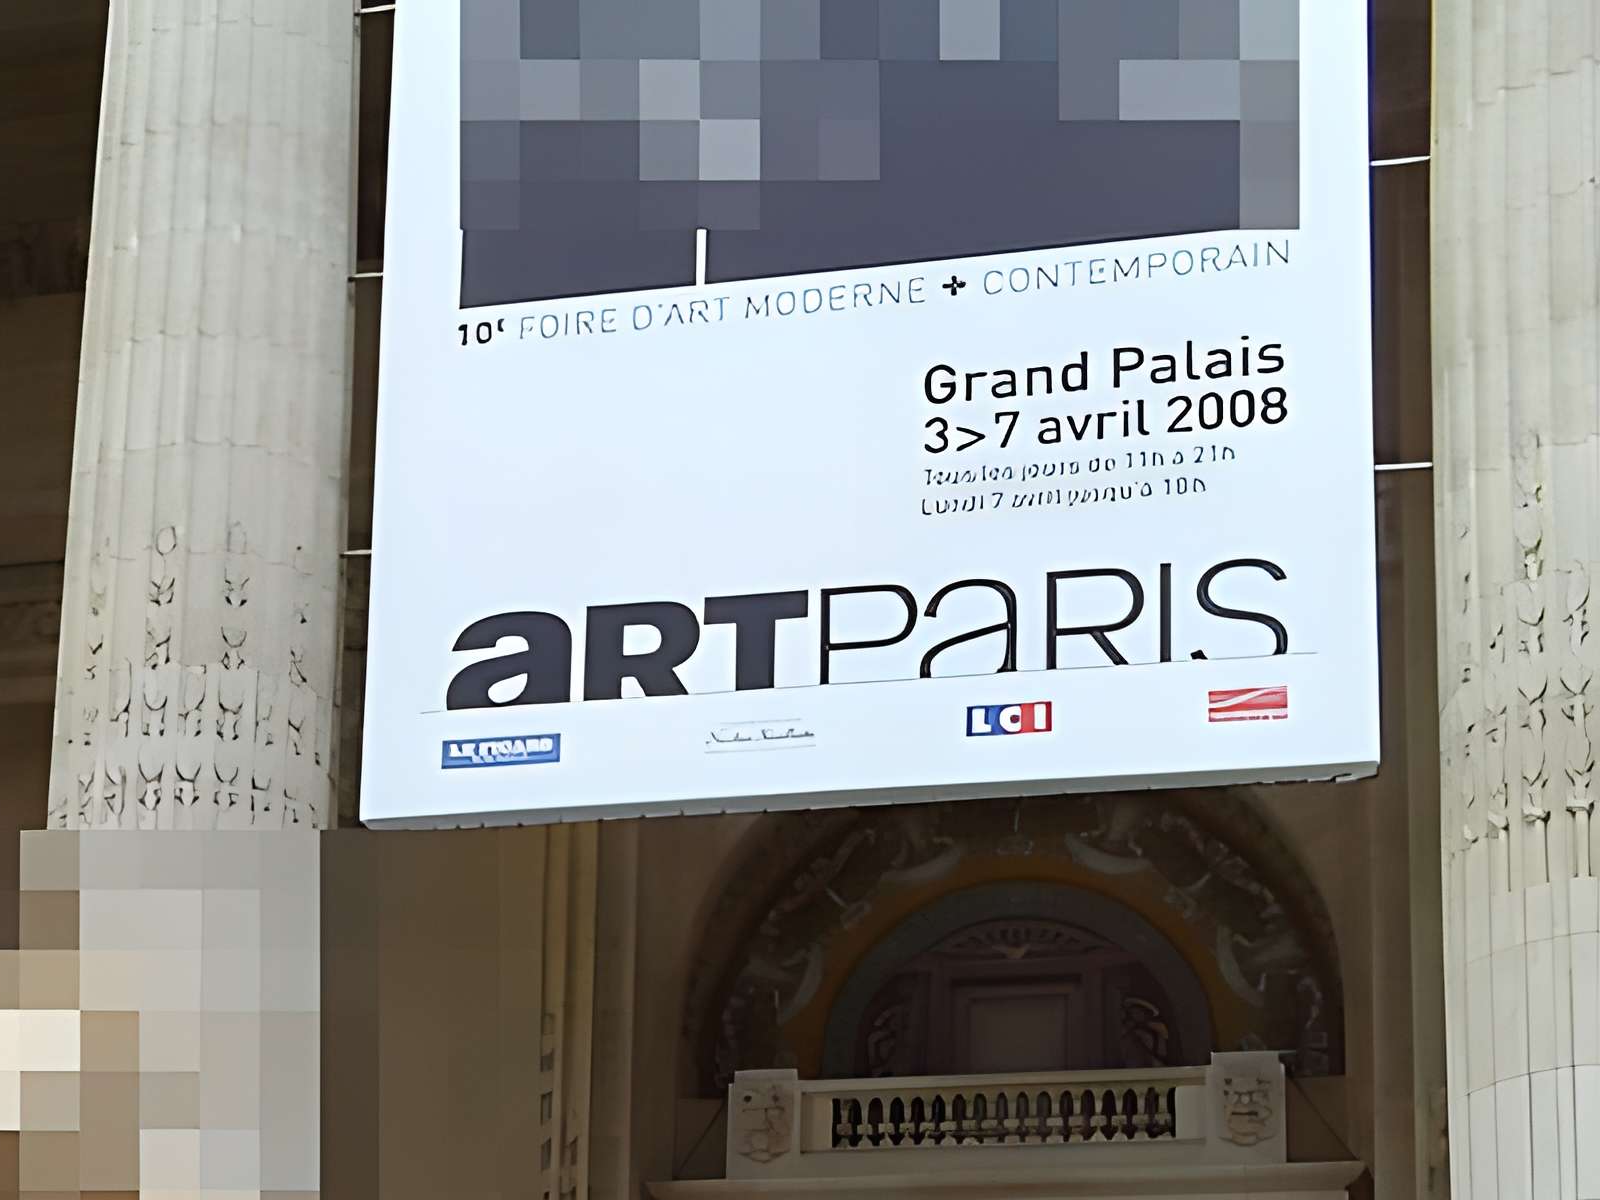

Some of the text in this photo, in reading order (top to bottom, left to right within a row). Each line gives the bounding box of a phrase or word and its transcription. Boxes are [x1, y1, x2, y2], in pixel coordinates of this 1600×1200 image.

[519, 308, 617, 340] FOIRE
[632, 296, 730, 331] D'ART
[744, 276, 926, 319] MODERNE
[941, 274, 967, 297] +
[983, 239, 1289, 296] CONTEMPORAIN
[923, 334, 1285, 405] Grand Palais
[923, 386, 1289, 454] 3>7 avril 2008
[971, 703, 1047, 734] LCI
